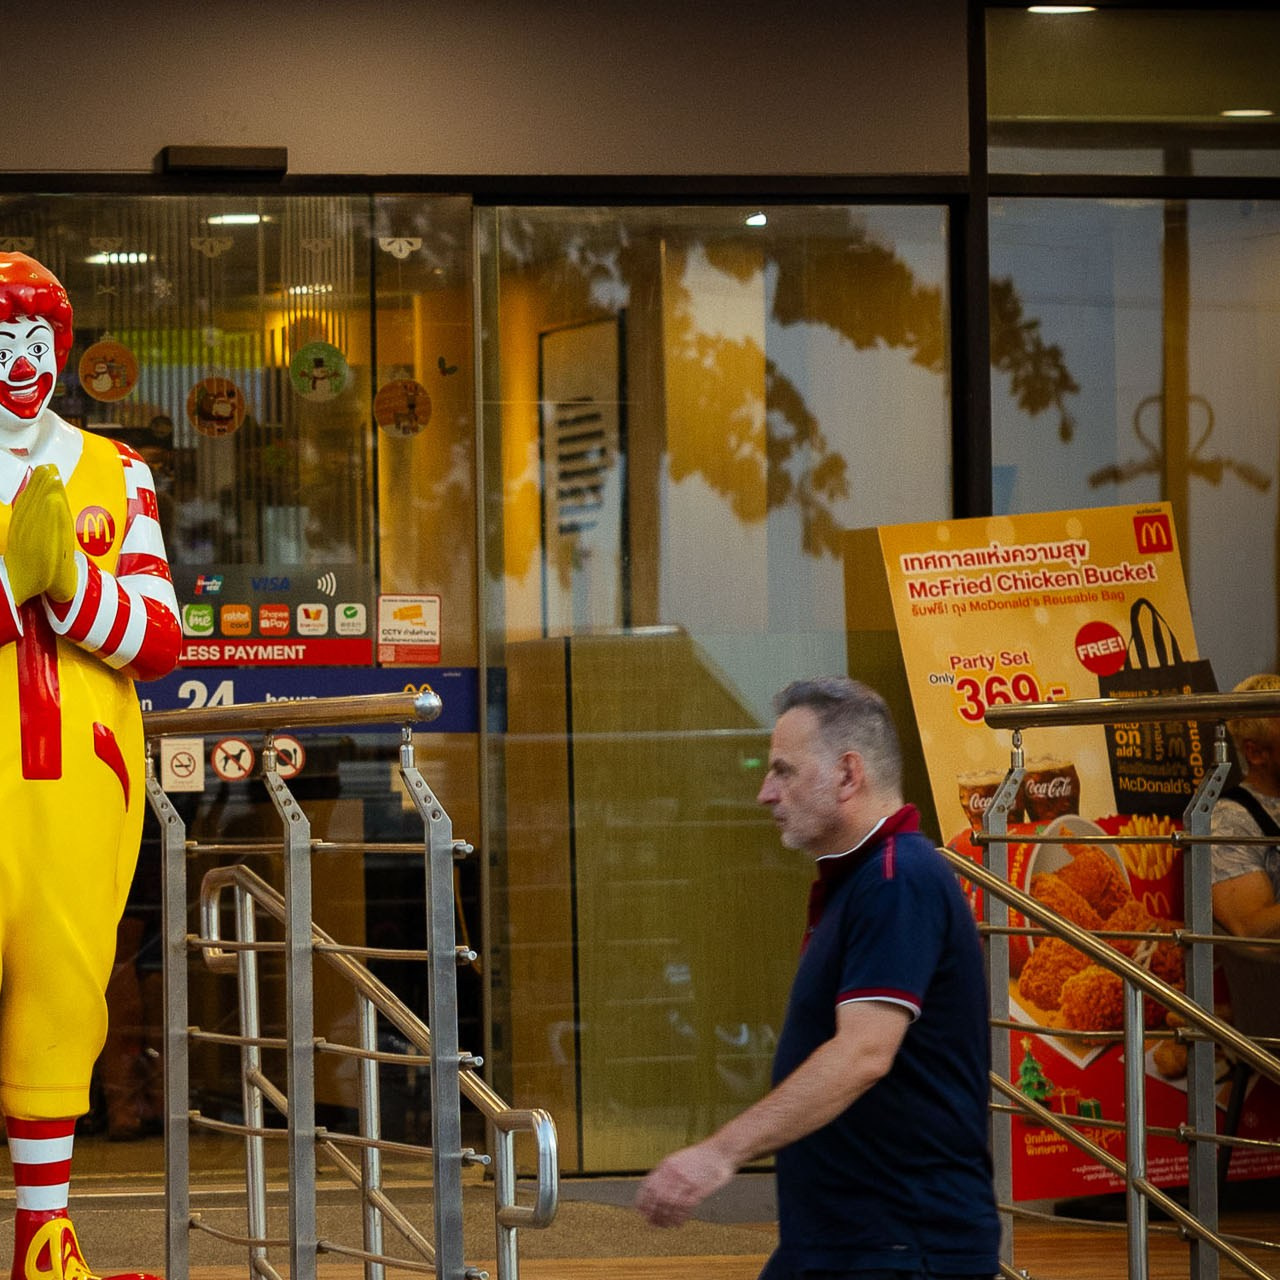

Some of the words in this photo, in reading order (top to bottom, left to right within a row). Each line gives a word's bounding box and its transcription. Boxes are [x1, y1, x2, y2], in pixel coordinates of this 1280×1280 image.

[903, 542, 1087, 571] เทศกาลแห่งความสุข
[908, 576, 992, 599] McFried
[997, 570, 1080, 593] Chicken
[1084, 562, 1156, 586] Bucket
[969, 595, 1039, 612] McDonald's
[1043, 591, 1098, 607] Reusable
[1101, 589, 1125, 603] Bag
[224, 645, 306, 660] PAYMENT
[1077, 635, 1125, 661] FREE!
[949, 654, 995, 671] Party
[1000, 651, 1030, 667] Set
[929, 672, 955, 686] Only
[1115, 730, 1141, 746] on
[1119, 776, 1191, 795] McDonald's
